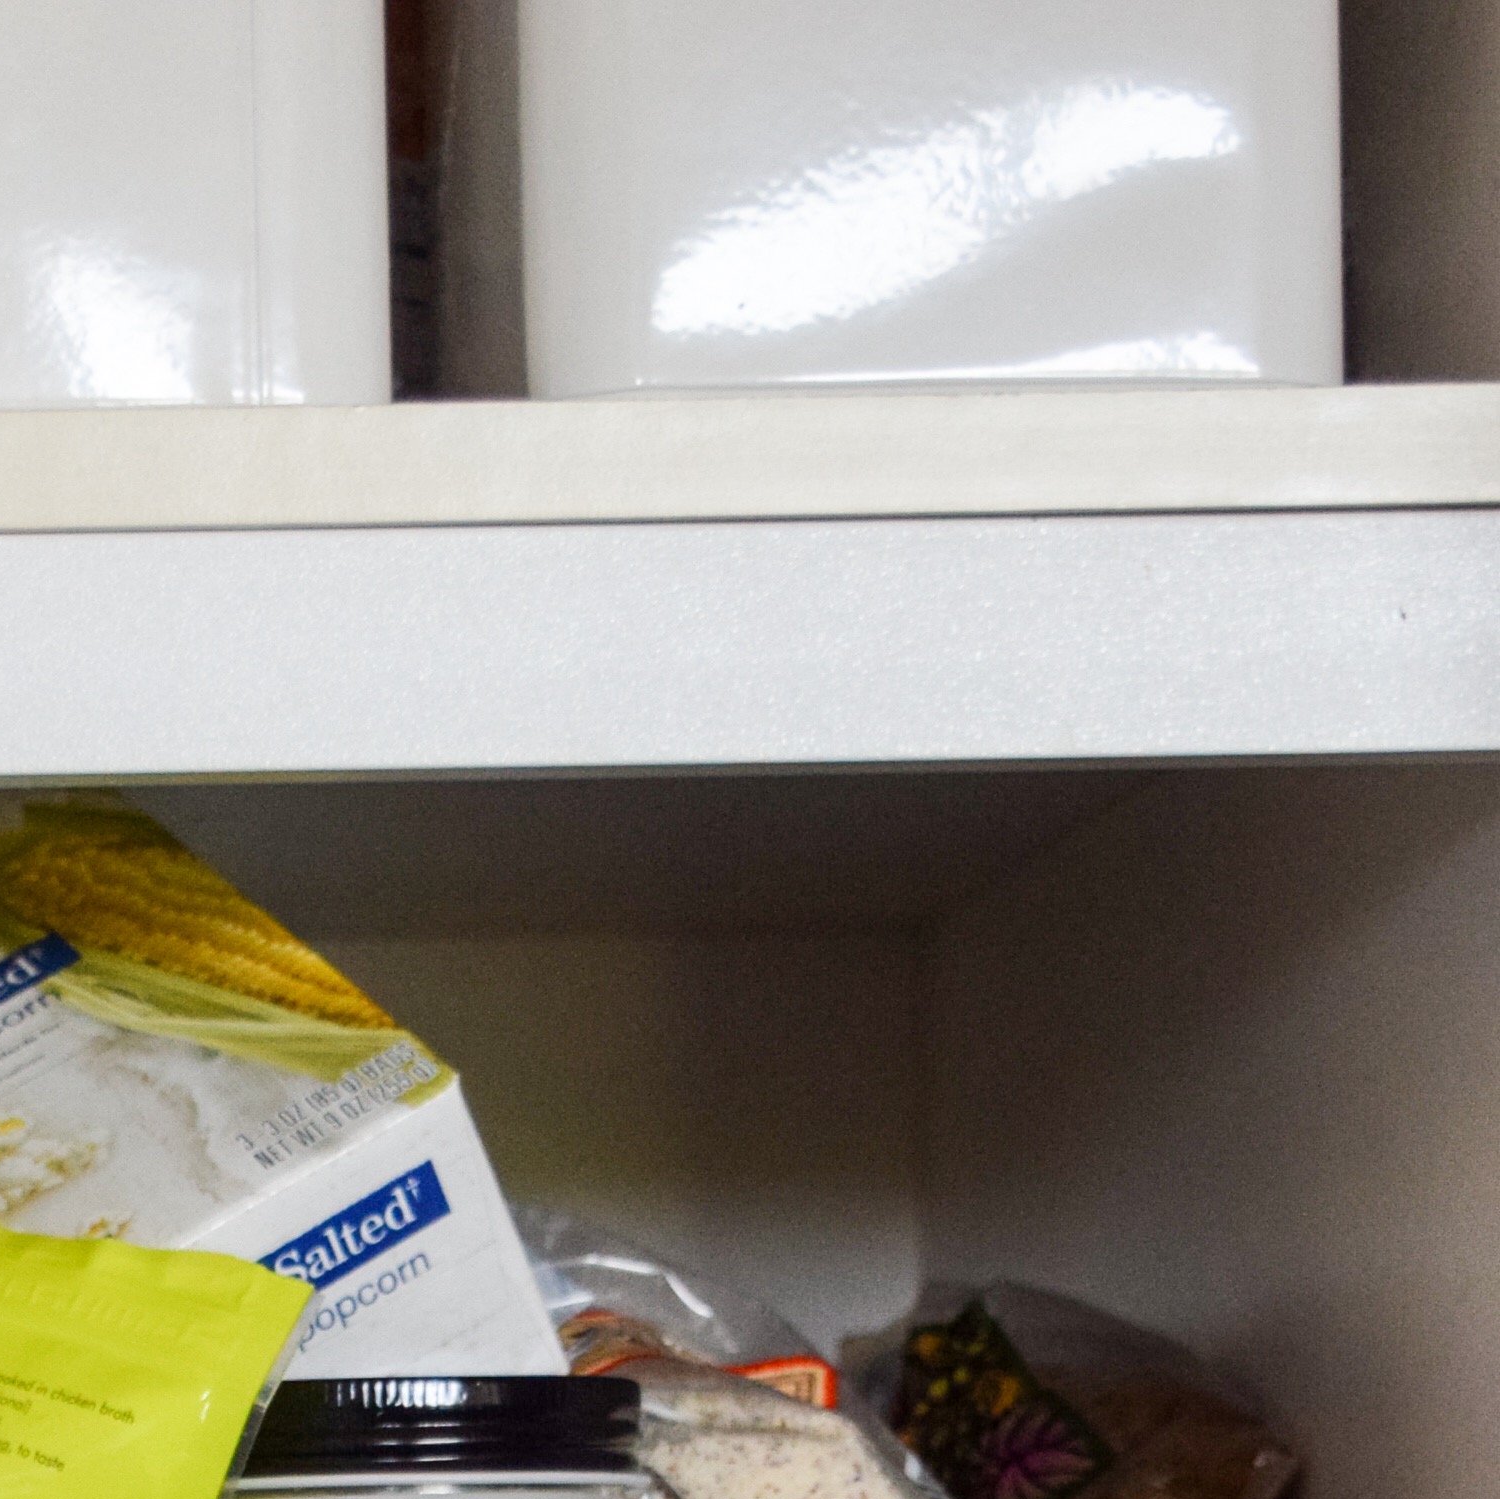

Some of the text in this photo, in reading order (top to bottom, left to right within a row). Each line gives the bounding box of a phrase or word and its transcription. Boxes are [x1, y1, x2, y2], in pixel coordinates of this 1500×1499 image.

[253, 1139, 293, 1170] NET
[294, 1121, 326, 1149] WT
[340, 1098, 371, 1121] OZ
